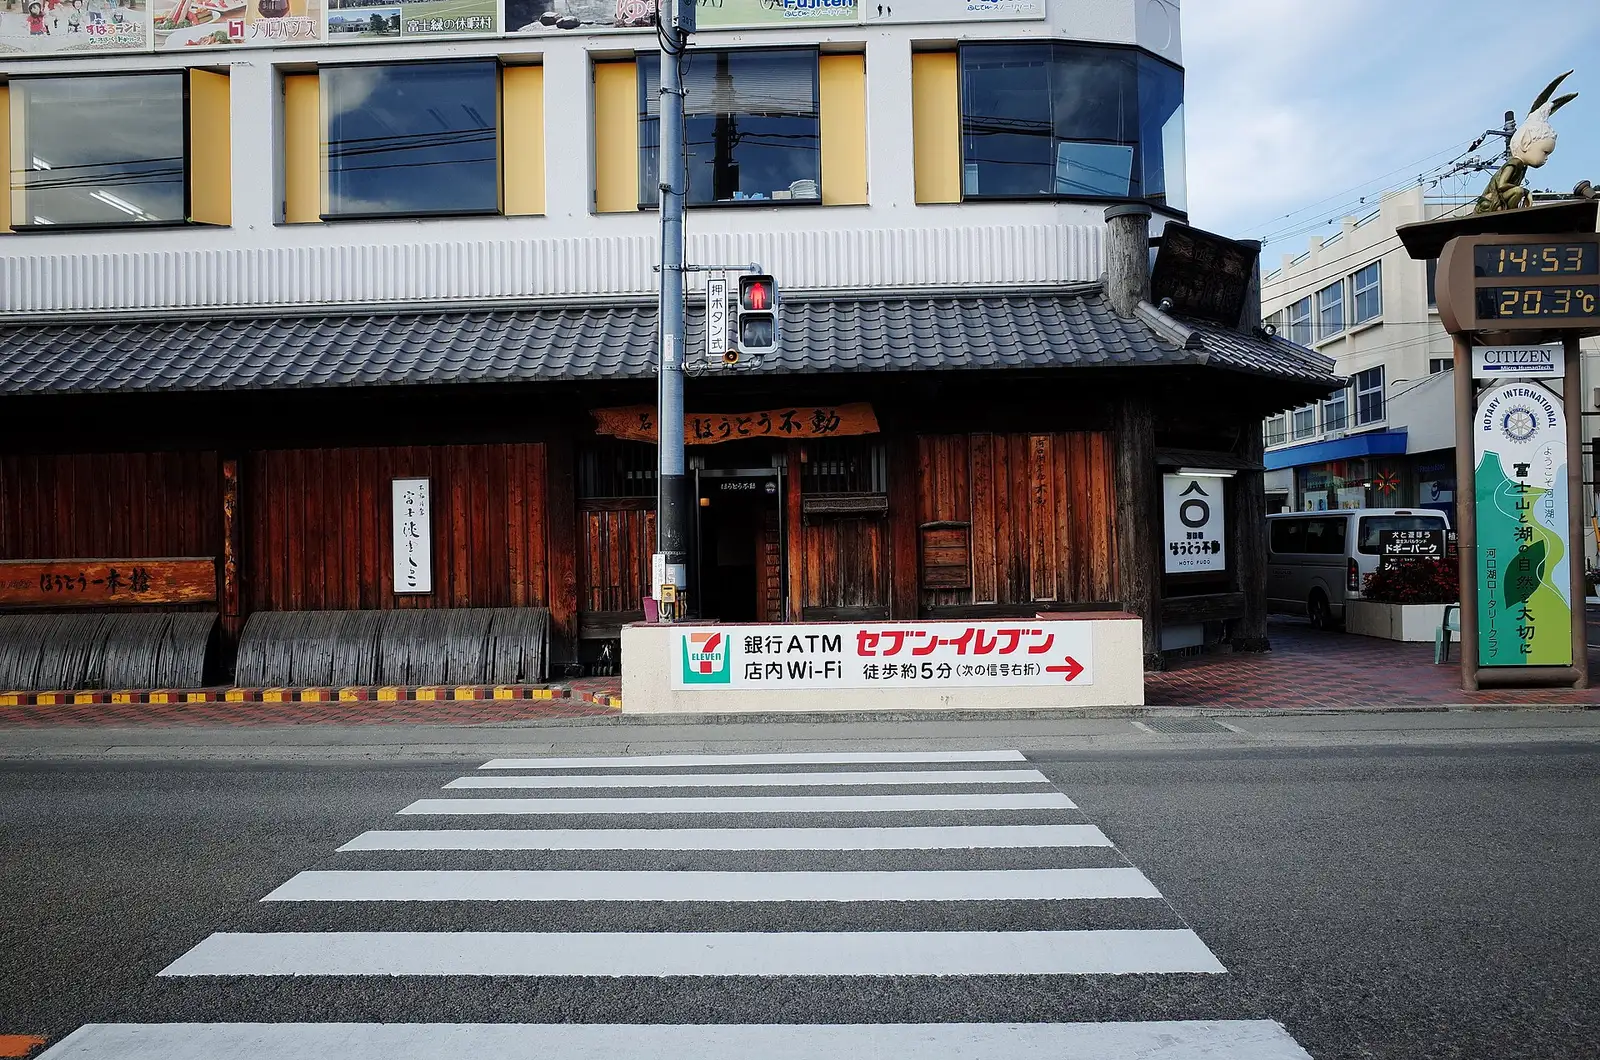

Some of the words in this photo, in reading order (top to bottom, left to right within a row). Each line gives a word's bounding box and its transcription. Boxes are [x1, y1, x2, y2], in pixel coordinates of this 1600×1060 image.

[407, 16, 491, 32] 富士緑の休暇村
[1498, 248, 1583, 273] 14:53
[711, 284, 723, 350] 押ボタン式
[1484, 350, 1552, 363] CITIZEN
[1484, 398, 1501, 431] ROTARY
[1503, 388, 1557, 428] INTERNATIONAL
[694, 409, 841, 439] ほうとう不動
[1543, 447, 1555, 527] ようこそ河口湖へ
[1392, 531, 1431, 539] 犬と遊ぼう
[1170, 540, 1221, 556] ほうとう不動
[1513, 462, 1536, 655] 富士山と湖の自然を大切に
[1486, 548, 1498, 658] 河口湖ロータリークラブ
[744, 635, 842, 654] 銀行ATM
[744, 661, 842, 680] 店内Wi-Fi
